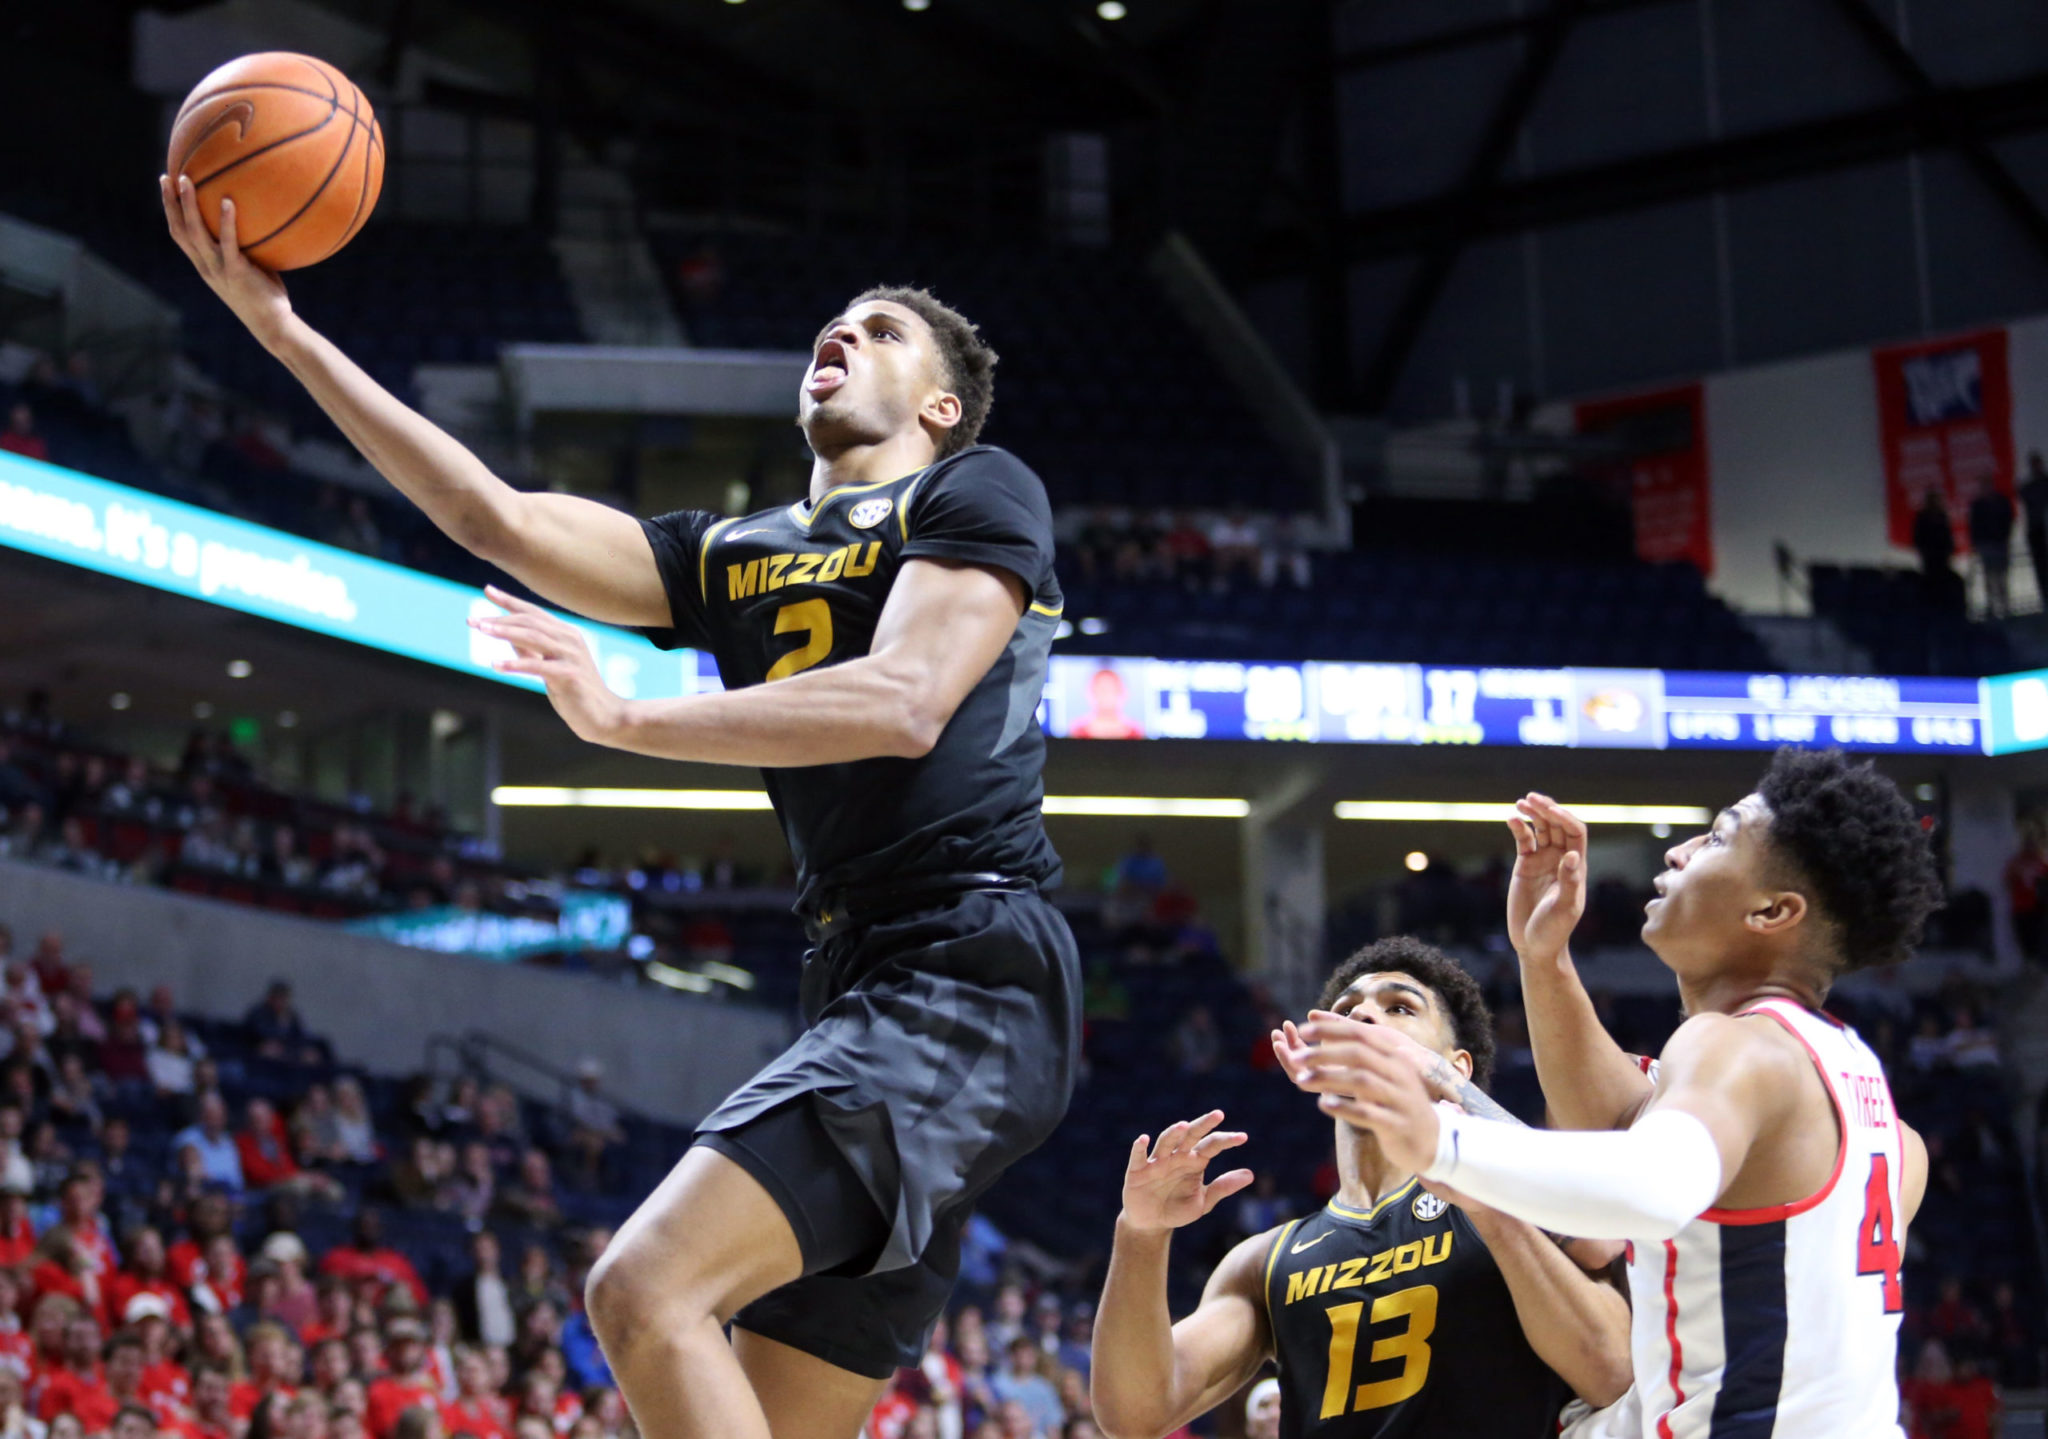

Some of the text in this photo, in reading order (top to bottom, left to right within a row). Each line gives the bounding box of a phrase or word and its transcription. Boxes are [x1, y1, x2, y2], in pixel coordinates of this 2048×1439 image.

[851, 501, 892, 527] SEC
[727, 541, 882, 601] MIZZOU
[766, 599, 833, 681] 2
[1286, 1231, 1453, 1305] MIZZOU
[1857, 1153, 1903, 1314] 4
[1320, 1284, 1438, 1419] 13
